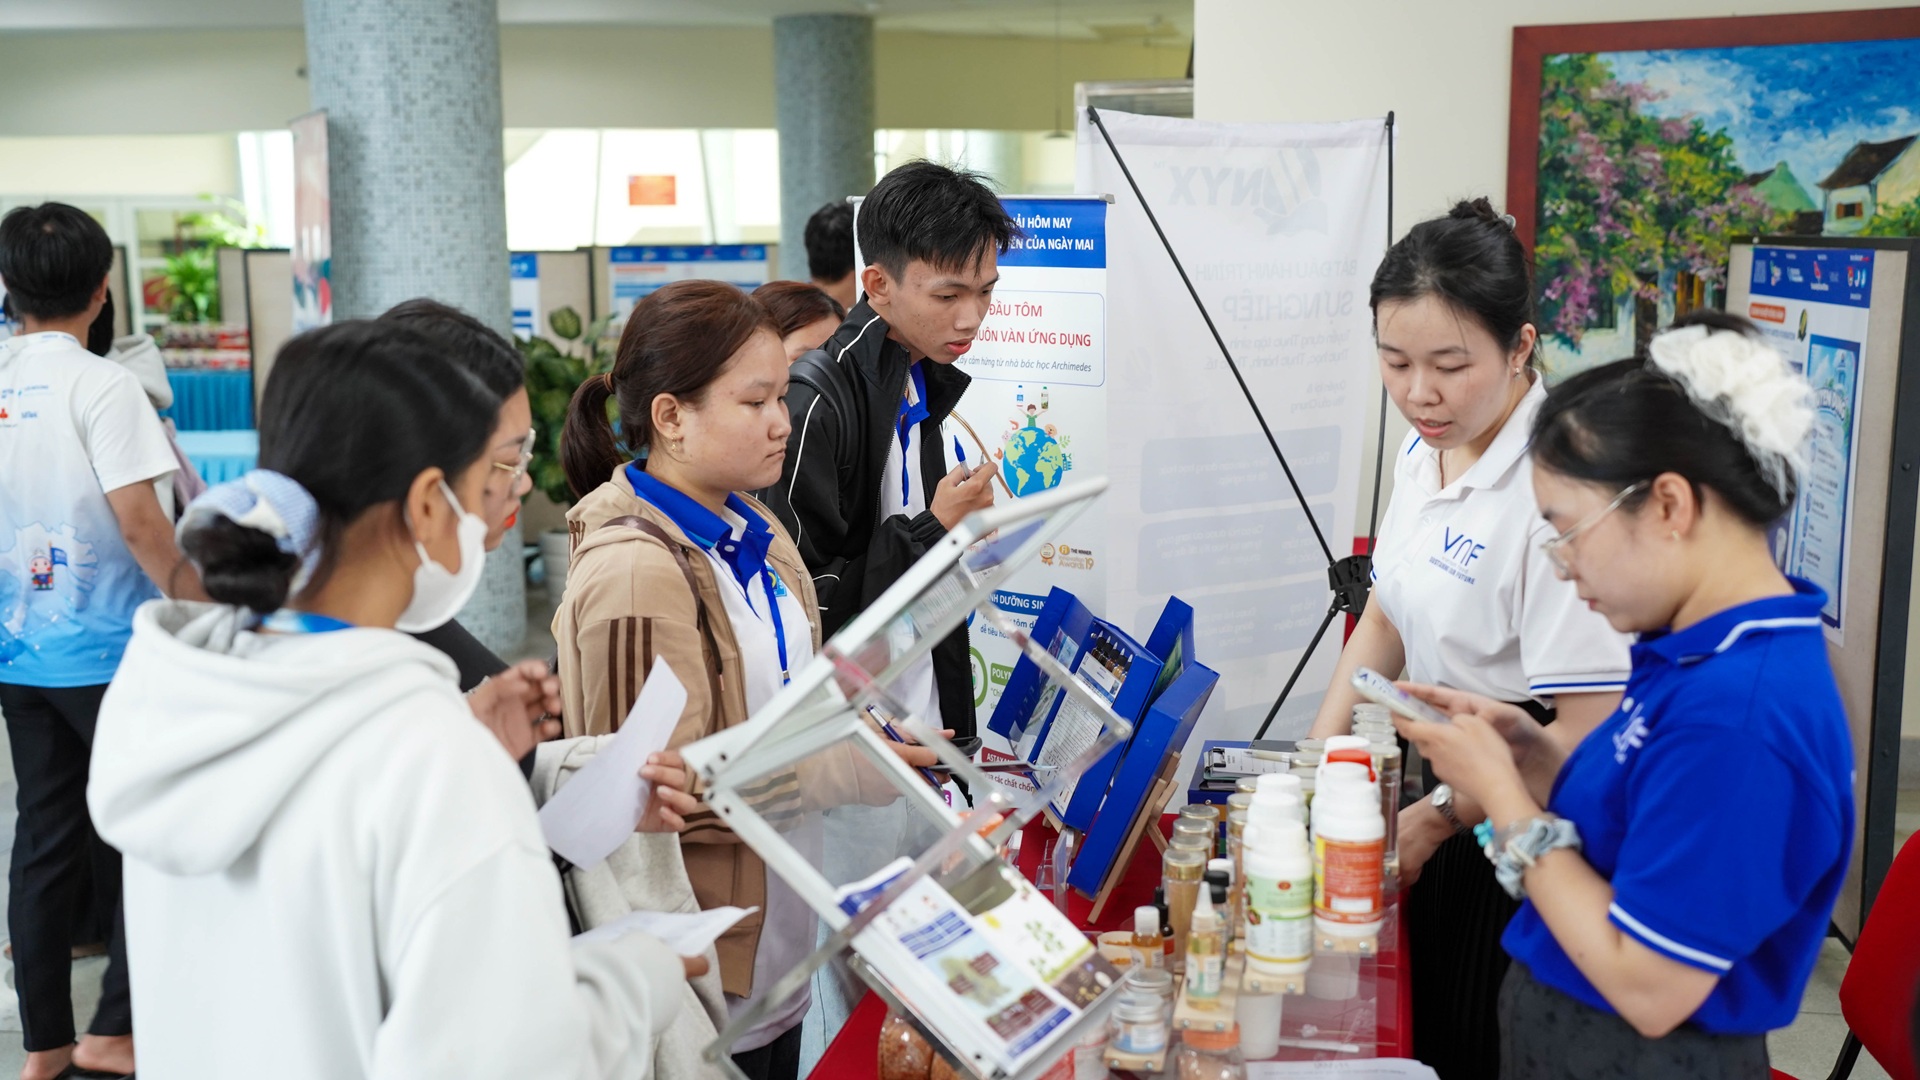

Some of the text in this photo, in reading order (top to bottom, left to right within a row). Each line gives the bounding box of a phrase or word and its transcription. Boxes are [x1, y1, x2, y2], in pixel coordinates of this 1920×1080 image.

[1027, 214, 1050, 229] HÔM
[1052, 217, 1072, 229] NAY
[1026, 234, 1046, 250] CỦA
[1048, 236, 1074, 251] NGÀY
[1075, 239, 1094, 251] MAI
[989, 299, 1043, 318] ĐẦU TÔM
[1000, 328, 1025, 343] VÀN
[1028, 328, 1056, 345] ỨNG
[1060, 332, 1091, 349] DỤNG
[1006, 357, 1018, 368] nhà
[1020, 358, 1034, 369] bác
[1036, 360, 1050, 371] học
[1051, 361, 1092, 373] Archimedes
[1000, 594, 1029, 609] DƯỠNG
